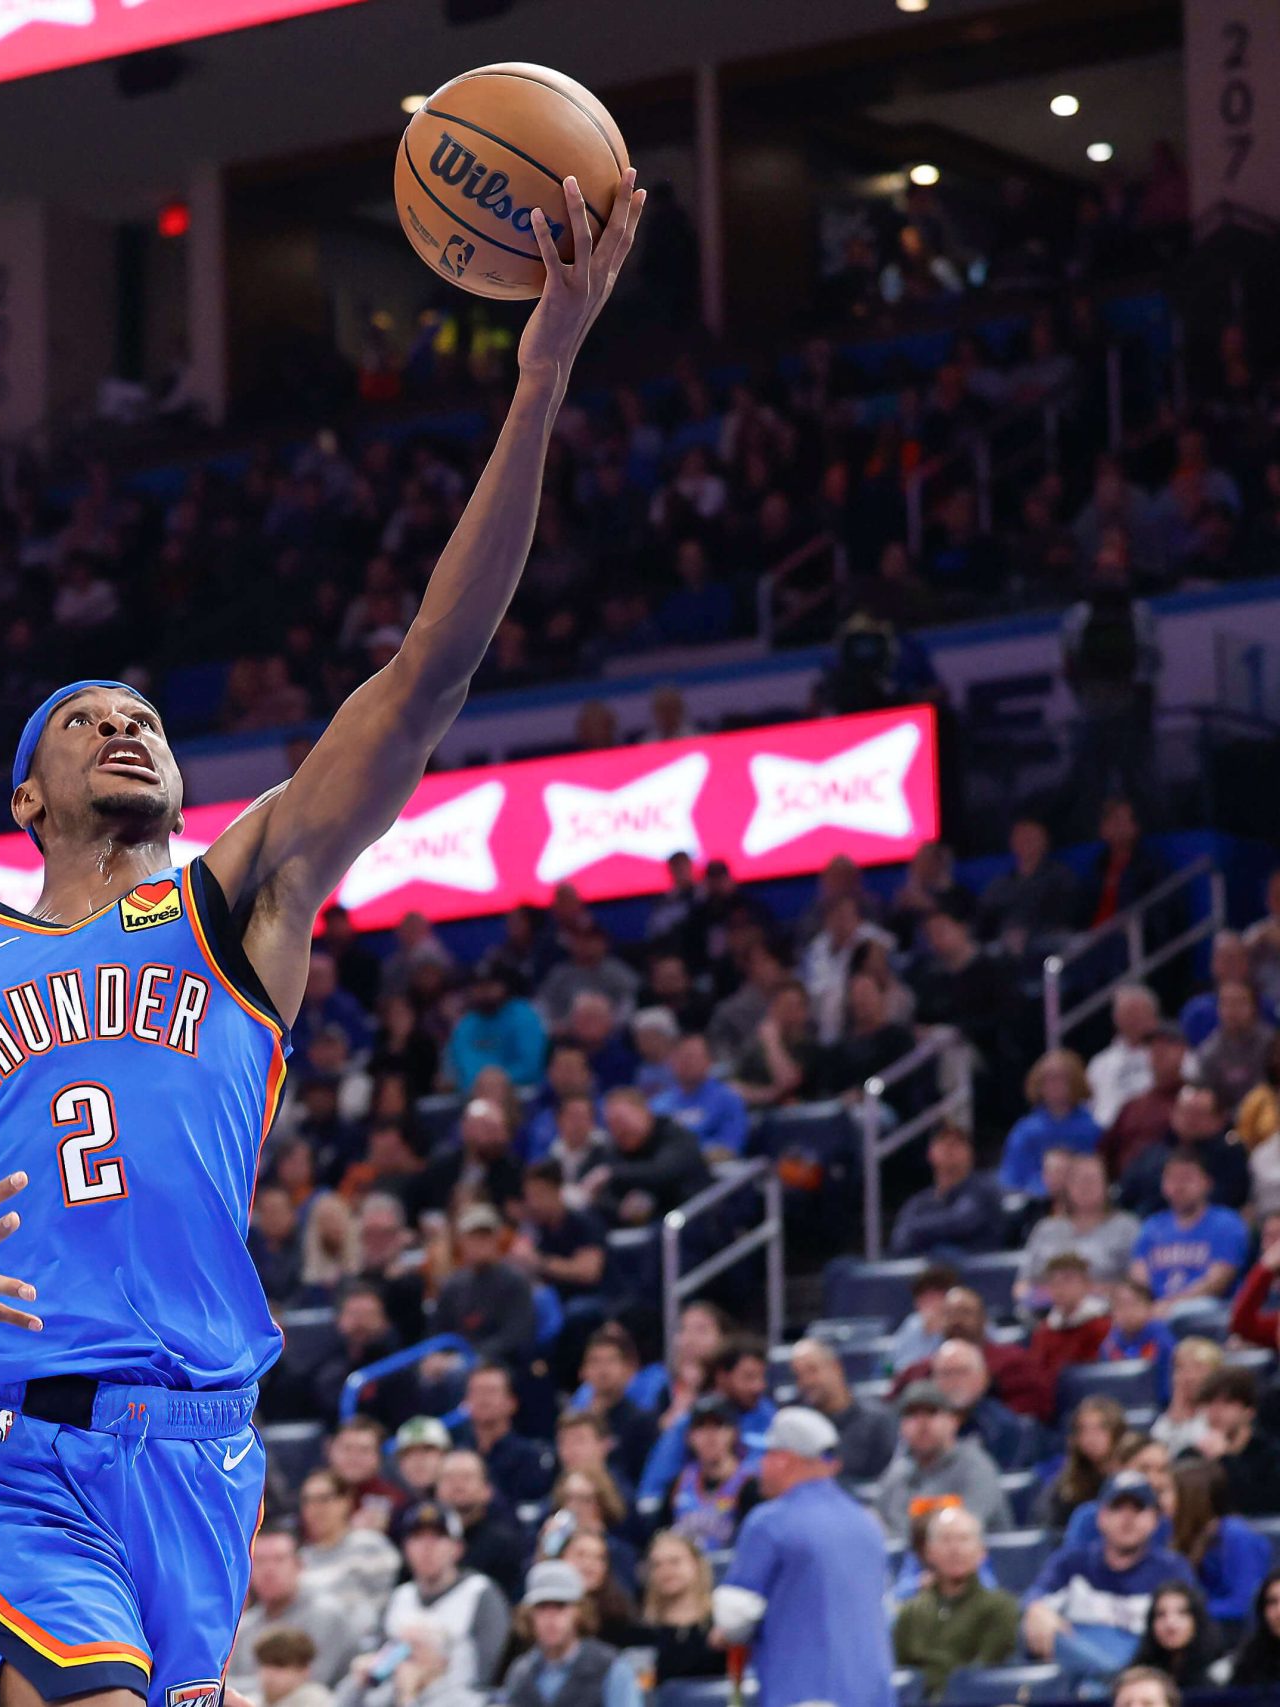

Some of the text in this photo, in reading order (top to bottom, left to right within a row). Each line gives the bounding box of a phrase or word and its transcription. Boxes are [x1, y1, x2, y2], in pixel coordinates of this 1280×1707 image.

[1221, 20, 1253, 182] 207
[770, 767, 891, 819] SONIC
[50, 1080, 128, 1207] 2
